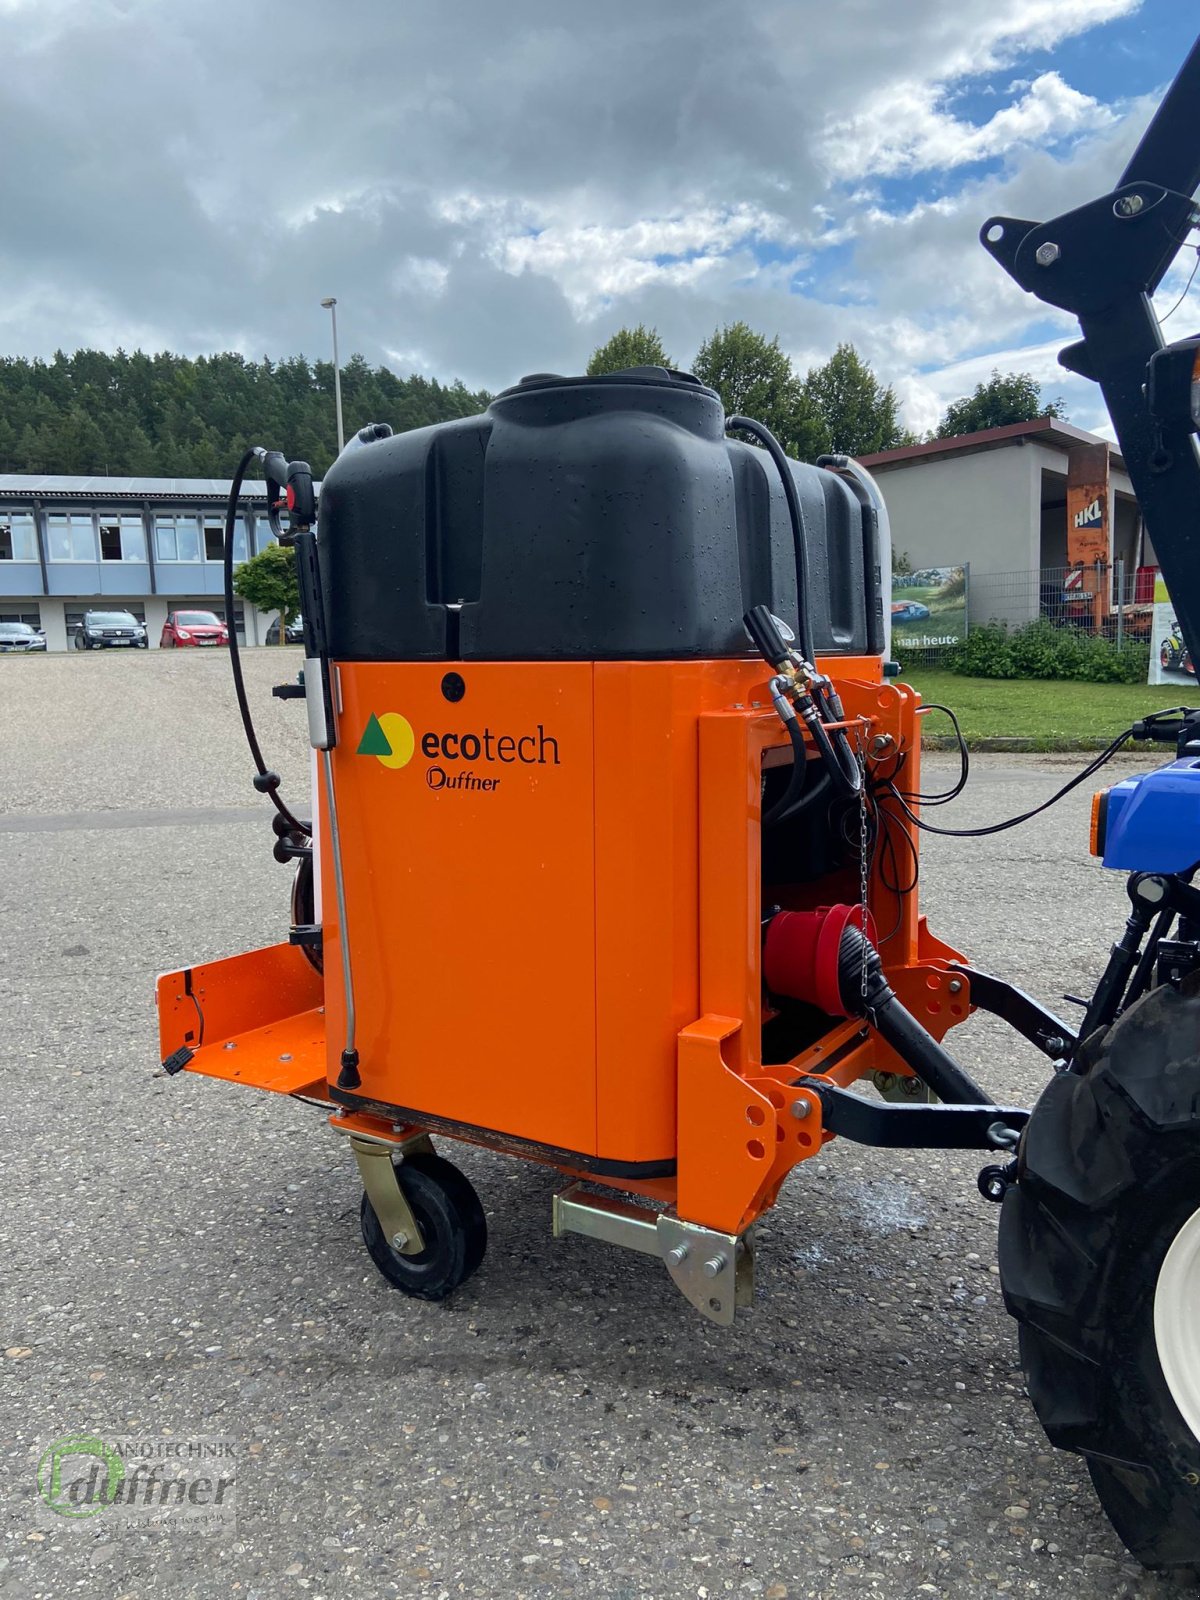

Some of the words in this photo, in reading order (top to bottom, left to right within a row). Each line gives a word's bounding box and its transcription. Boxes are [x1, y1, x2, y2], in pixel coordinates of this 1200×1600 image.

[1074, 499, 1102, 528] HKL
[923, 634, 959, 646] heute
[421, 724, 561, 765] ecotech
[426, 765, 501, 791] Duffner
